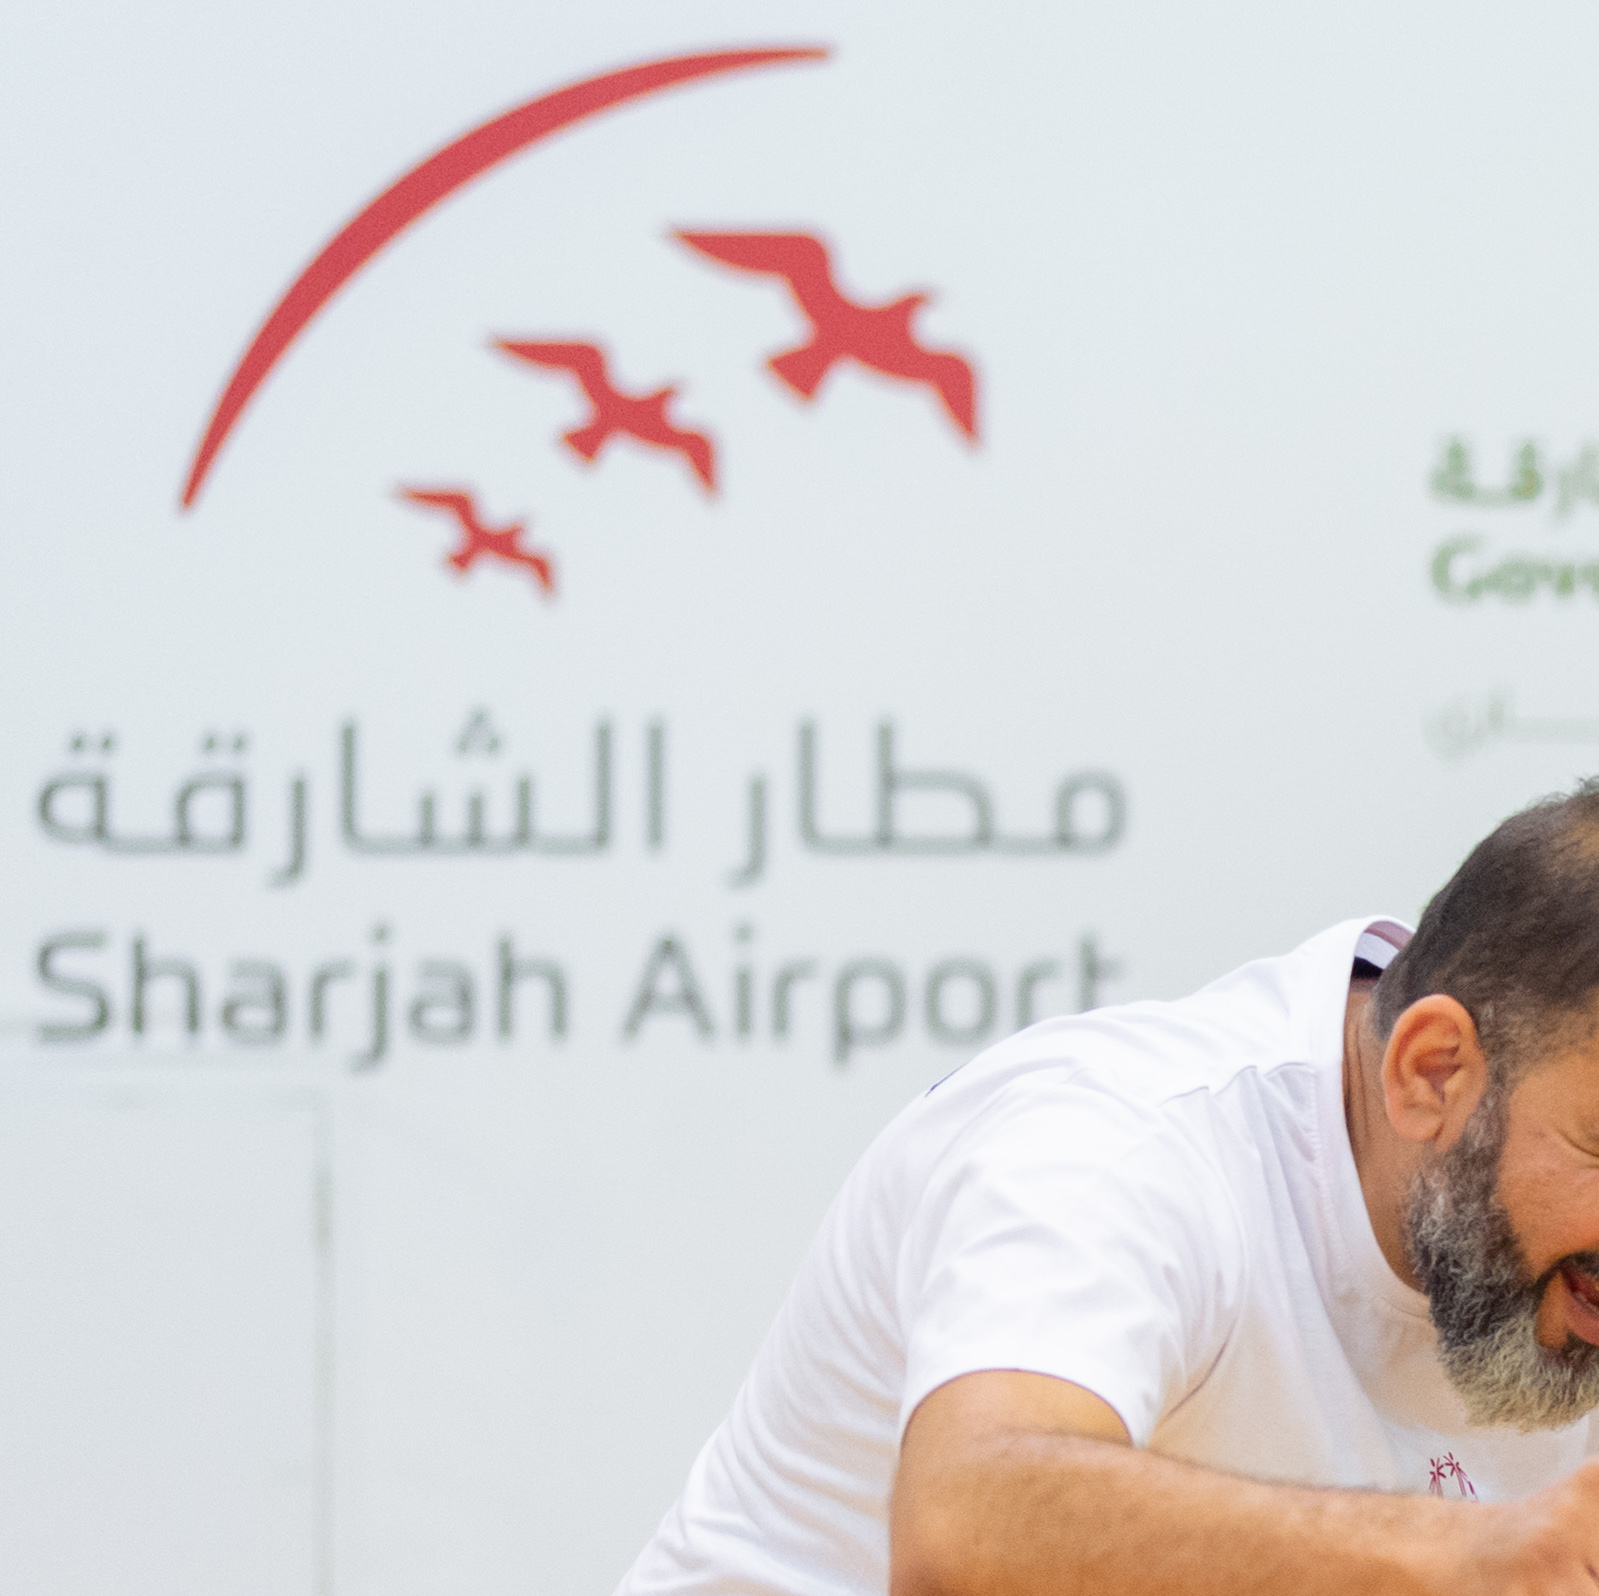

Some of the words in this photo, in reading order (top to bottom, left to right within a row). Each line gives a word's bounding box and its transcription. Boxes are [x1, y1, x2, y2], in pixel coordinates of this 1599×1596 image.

[36, 707, 666, 889] الشارقة
[729, 714, 1128, 889] مطار
[34, 920, 572, 1074] Sharjah
[620, 920, 1130, 1070] Airport
